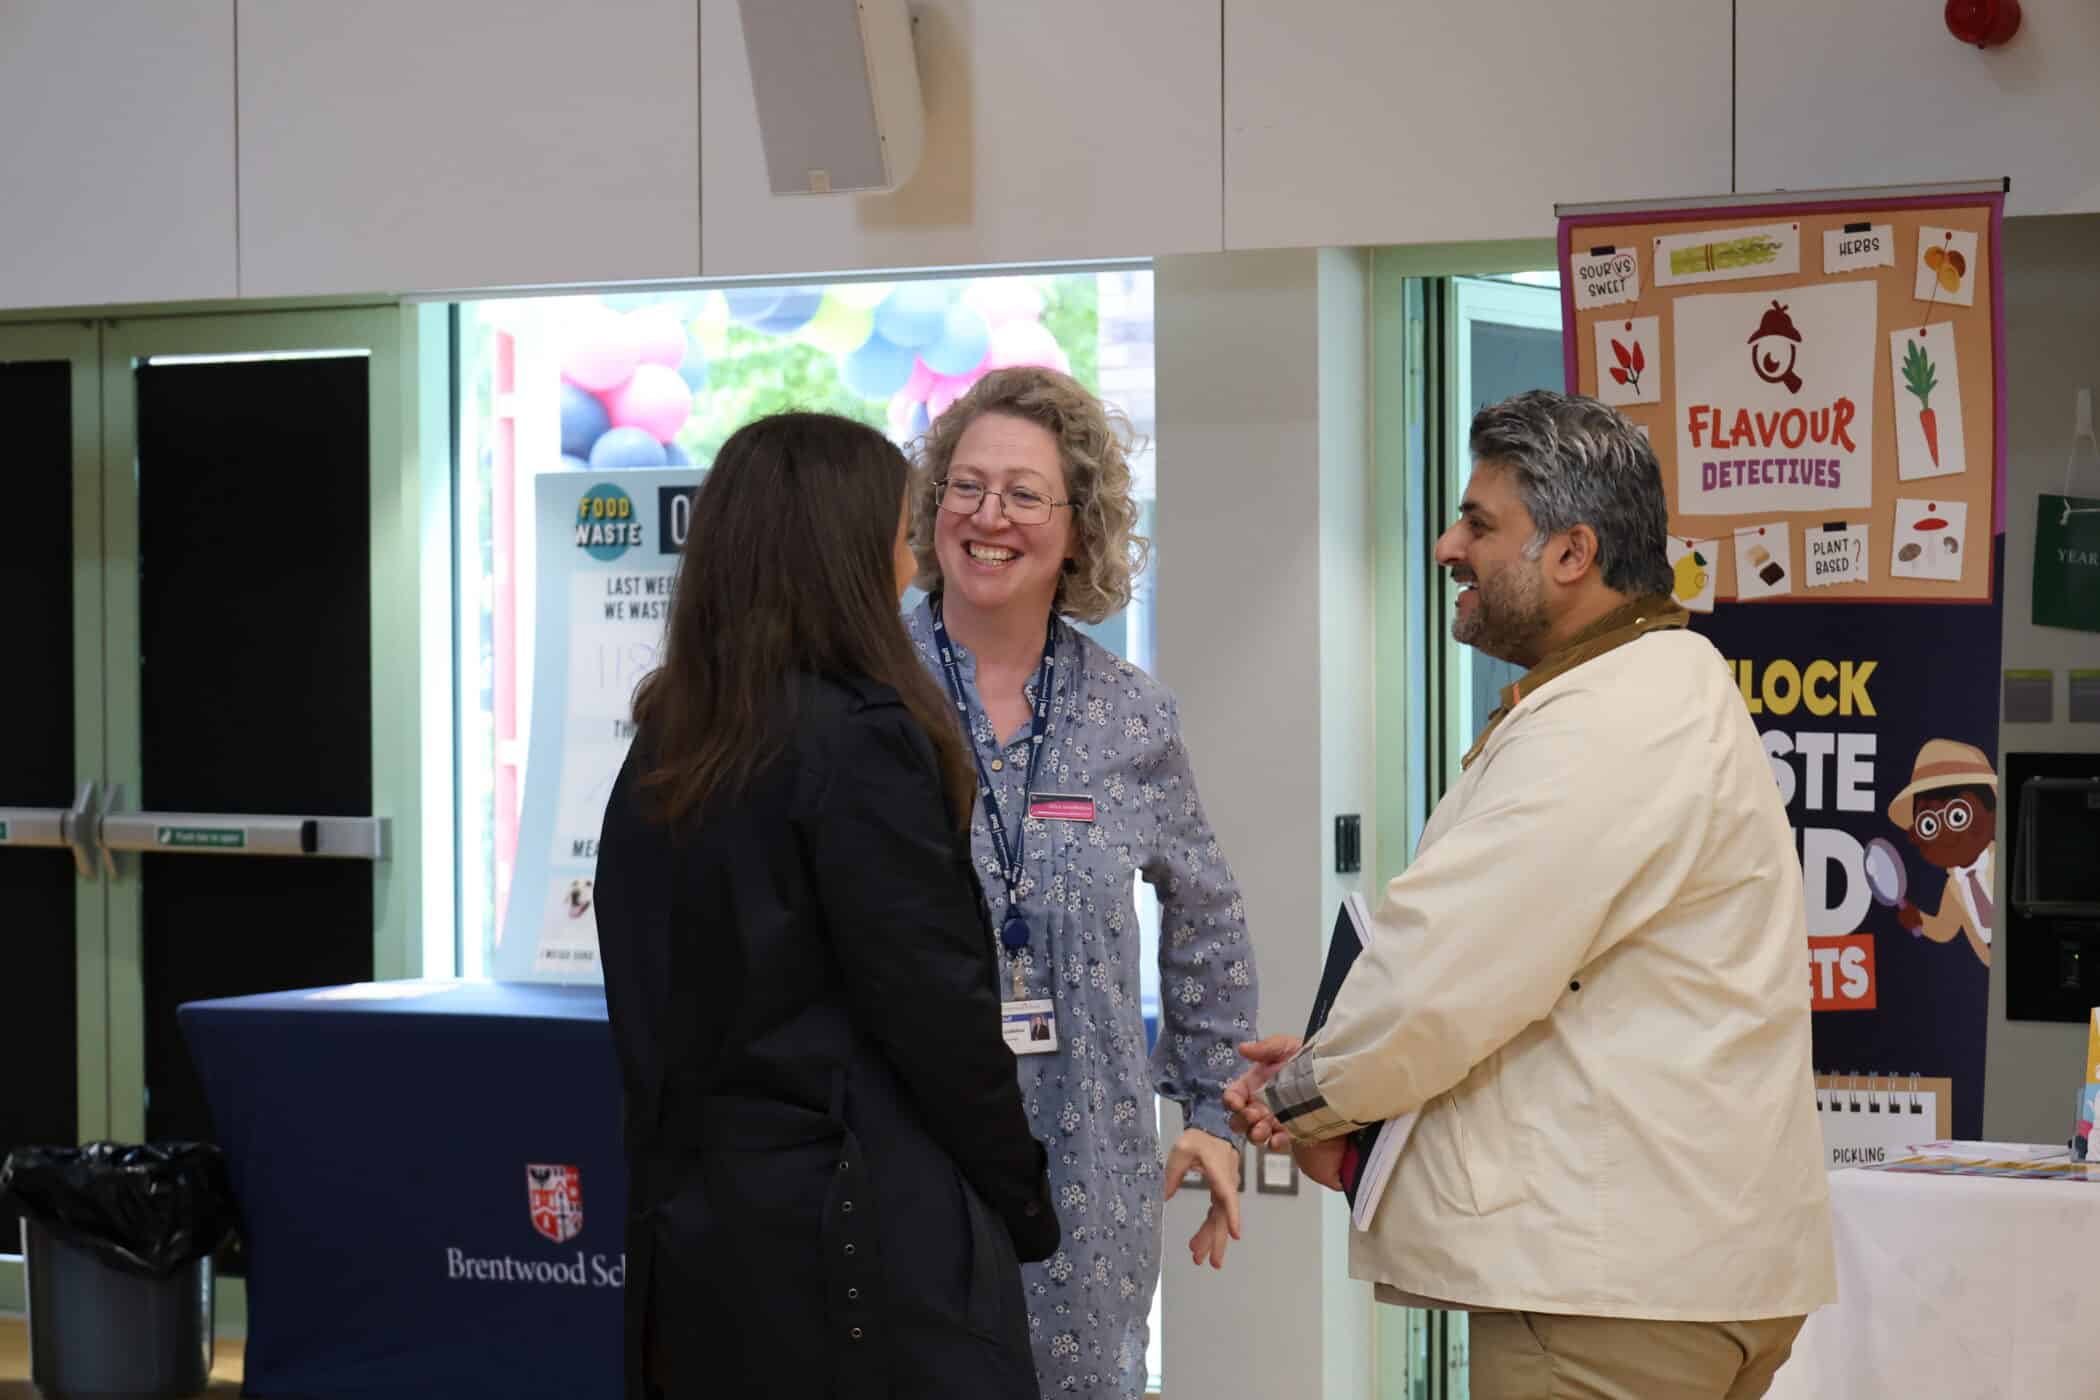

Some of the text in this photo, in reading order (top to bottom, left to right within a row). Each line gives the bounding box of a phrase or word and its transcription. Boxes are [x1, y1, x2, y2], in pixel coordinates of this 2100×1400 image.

[1839, 237, 1880, 257] HERBS
[1579, 258, 1632, 280] SOUR VS
[1588, 278, 1626, 297] SWEET
[1688, 396, 1857, 454] FLAVOUR
[1702, 458, 1841, 492] DETECTIVES
[579, 496, 632, 519] FOOD
[575, 523, 641, 547] WASTE
[1813, 538, 1849, 556] PLANT
[1816, 557, 1850, 576] BASED
[607, 576, 674, 596] LAST WEE
[604, 601, 668, 619] WE WAST
[1726, 658, 1879, 717] LOCK
[1760, 729, 1878, 812] STE
[1791, 827, 1873, 937] D
[1809, 946, 1869, 999] TS
[1832, 1146, 1886, 1163] PICKLING
[447, 1247, 587, 1286] Brentwood
